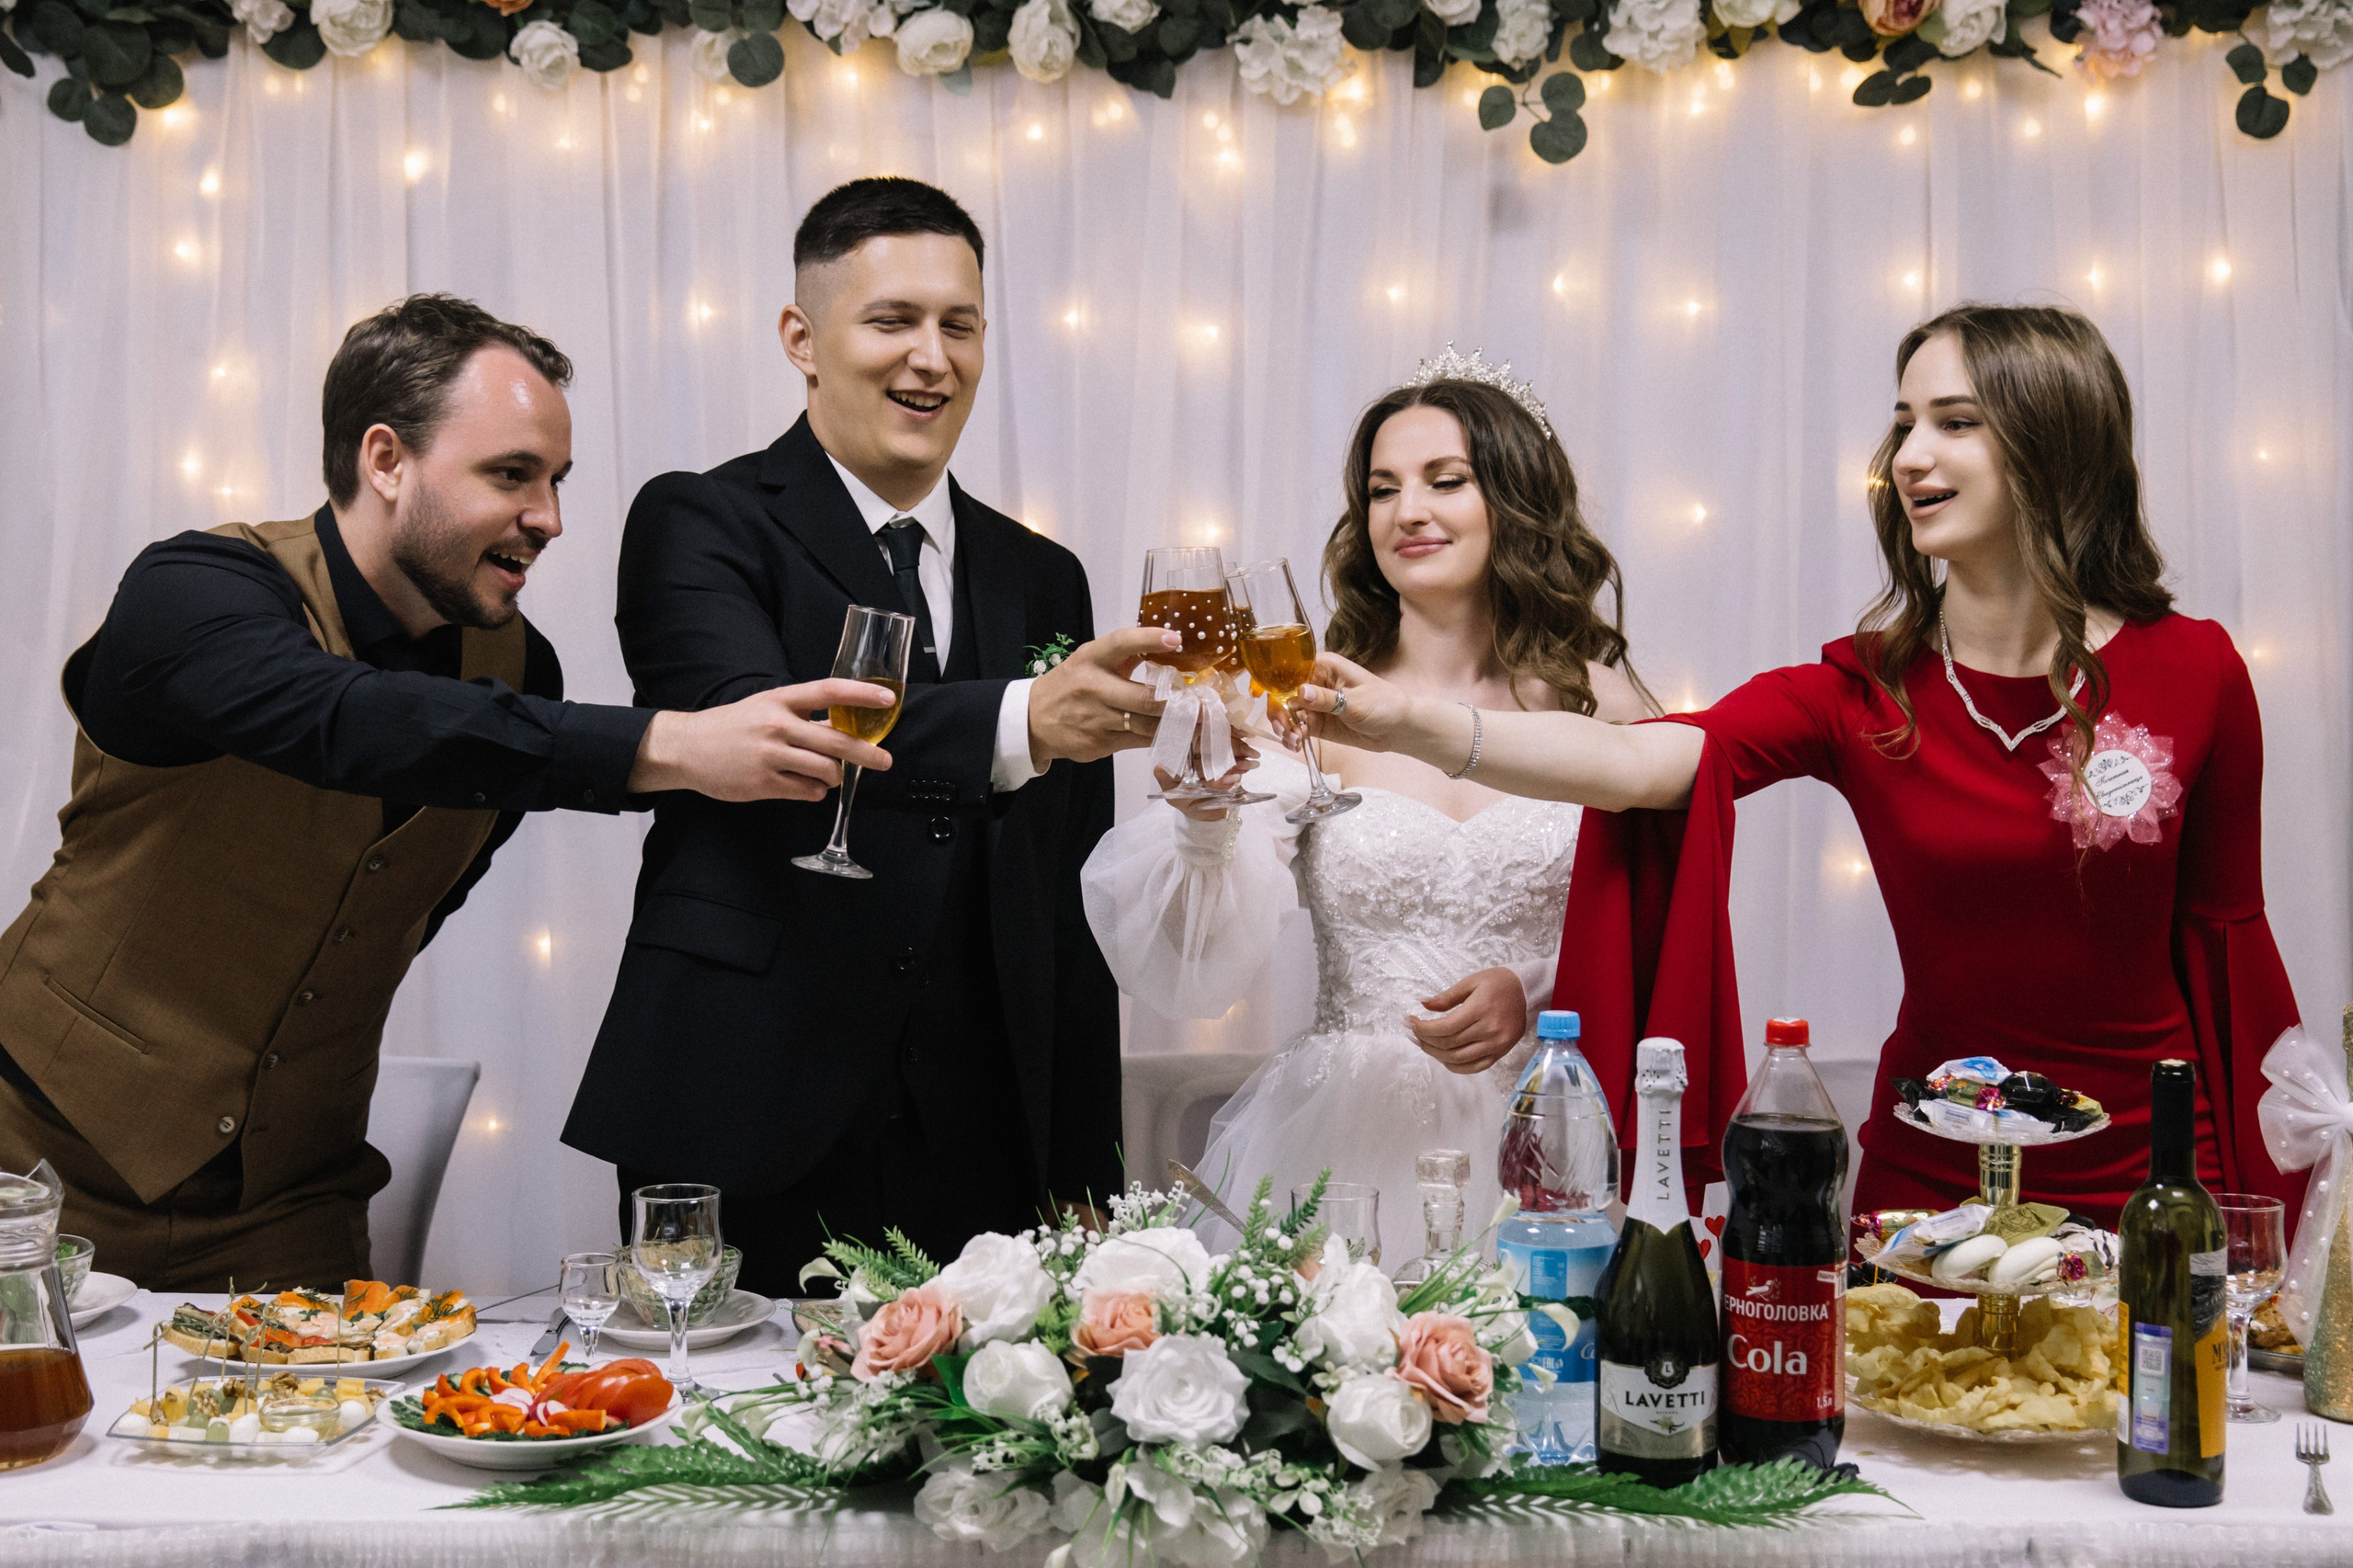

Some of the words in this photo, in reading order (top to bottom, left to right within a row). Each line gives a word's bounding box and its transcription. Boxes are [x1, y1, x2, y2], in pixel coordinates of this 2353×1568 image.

[1657, 1109, 1671, 1200] LAVETTI
[1722, 1292, 1828, 1321] ЕРНОГОЛОВКА
[1727, 1334, 1808, 1375] Cola
[1625, 1391, 1704, 1408] LAVETTI
